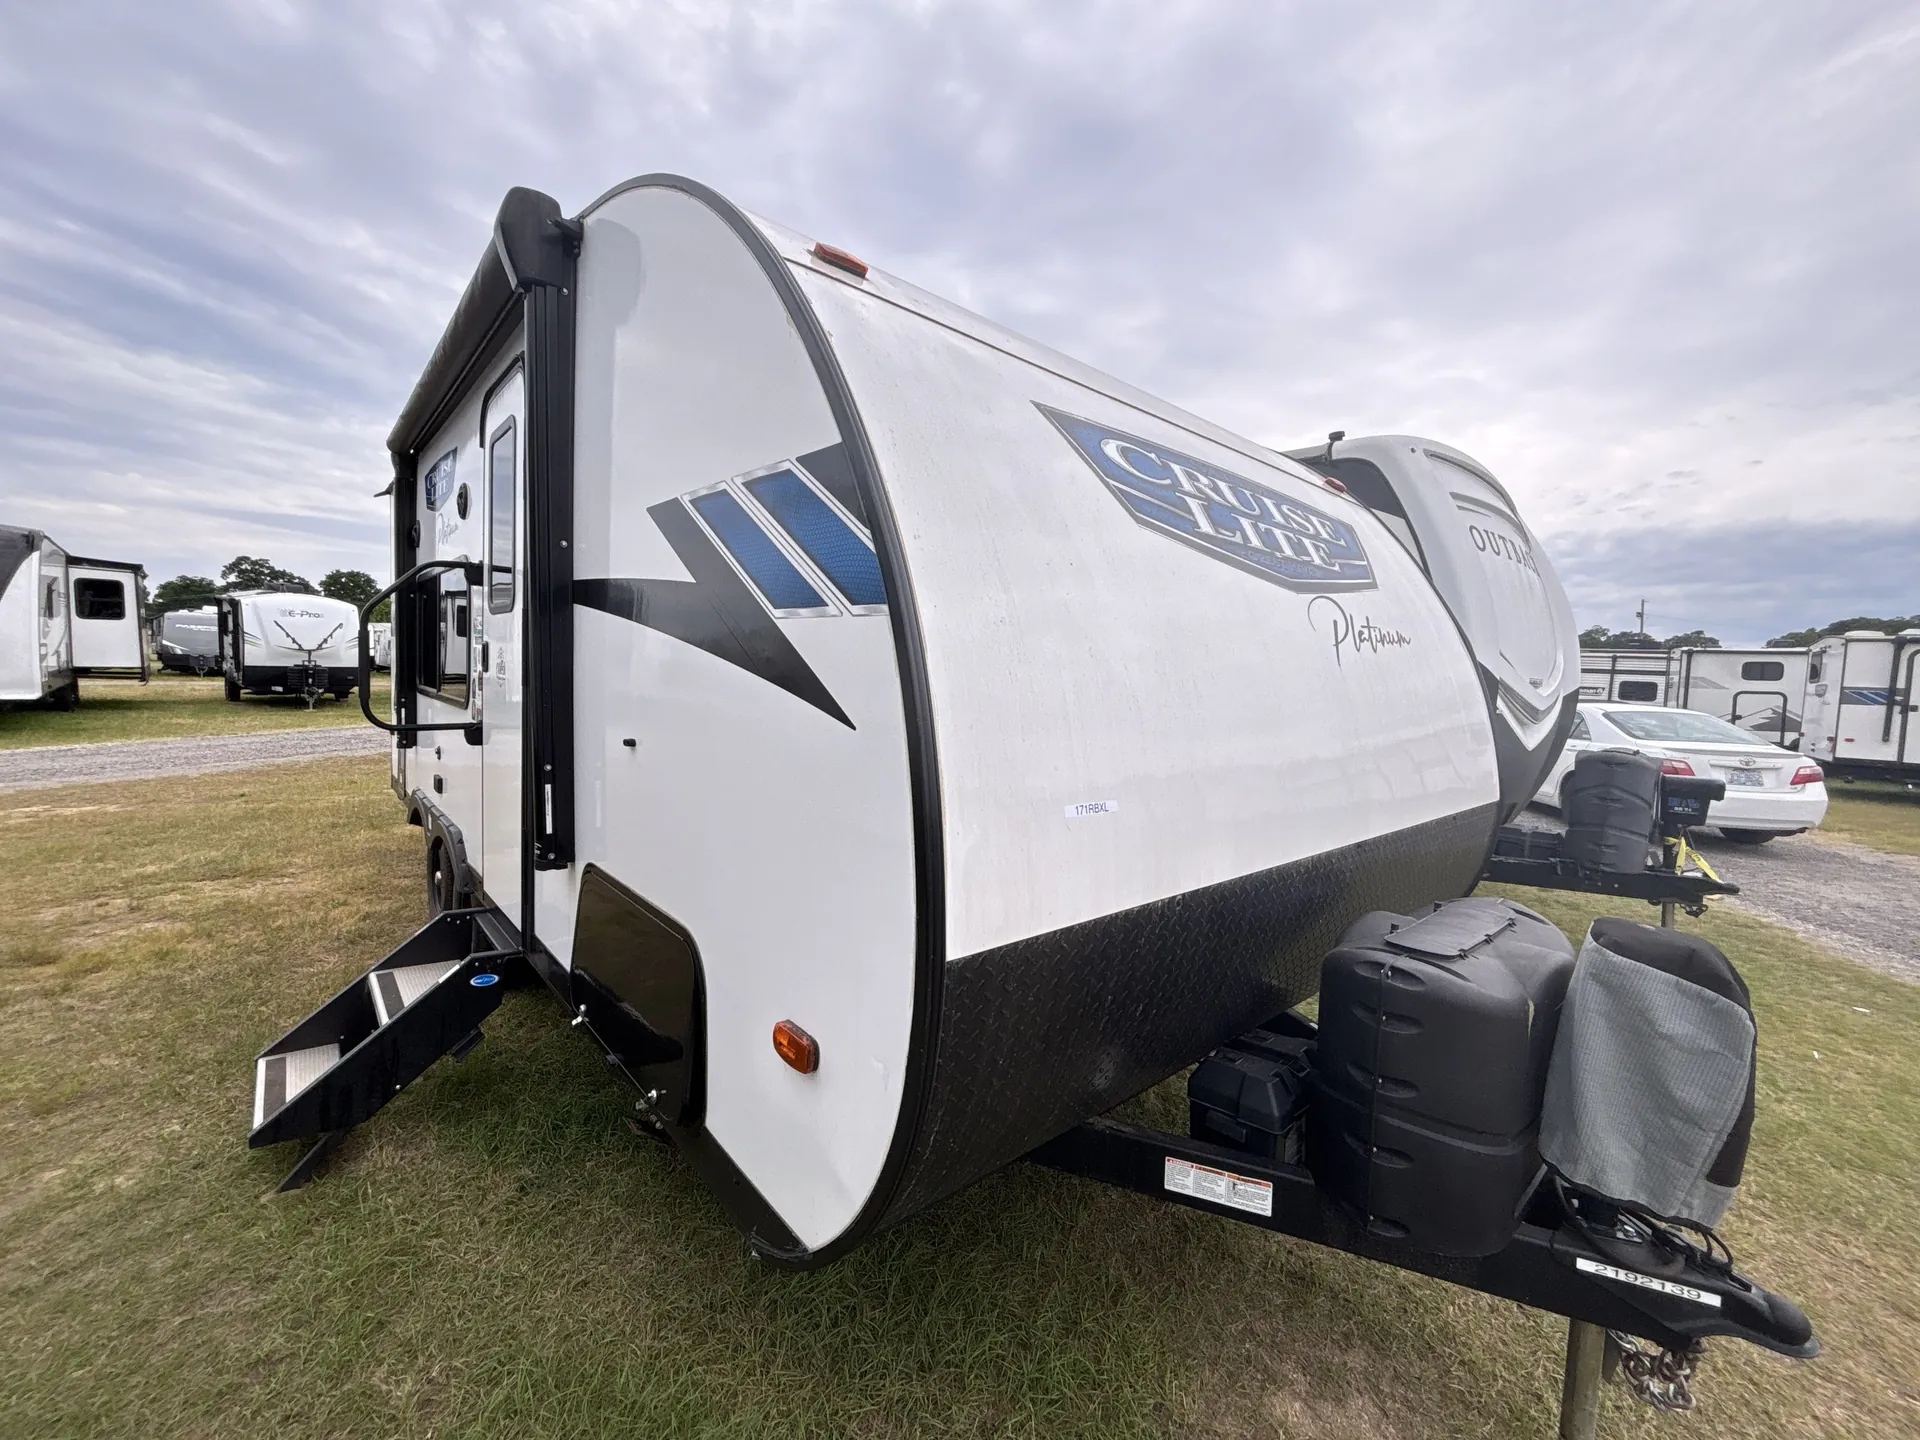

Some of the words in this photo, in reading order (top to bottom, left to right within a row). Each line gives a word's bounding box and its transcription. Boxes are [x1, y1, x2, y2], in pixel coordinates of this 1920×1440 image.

[1099, 438, 1347, 547] CRUISE
[1174, 491, 1342, 573] LITE
[1307, 594, 1412, 674] Platinum
[1075, 801, 1109, 816] 171RBXL
[1593, 1263, 1702, 1301] 2192139
